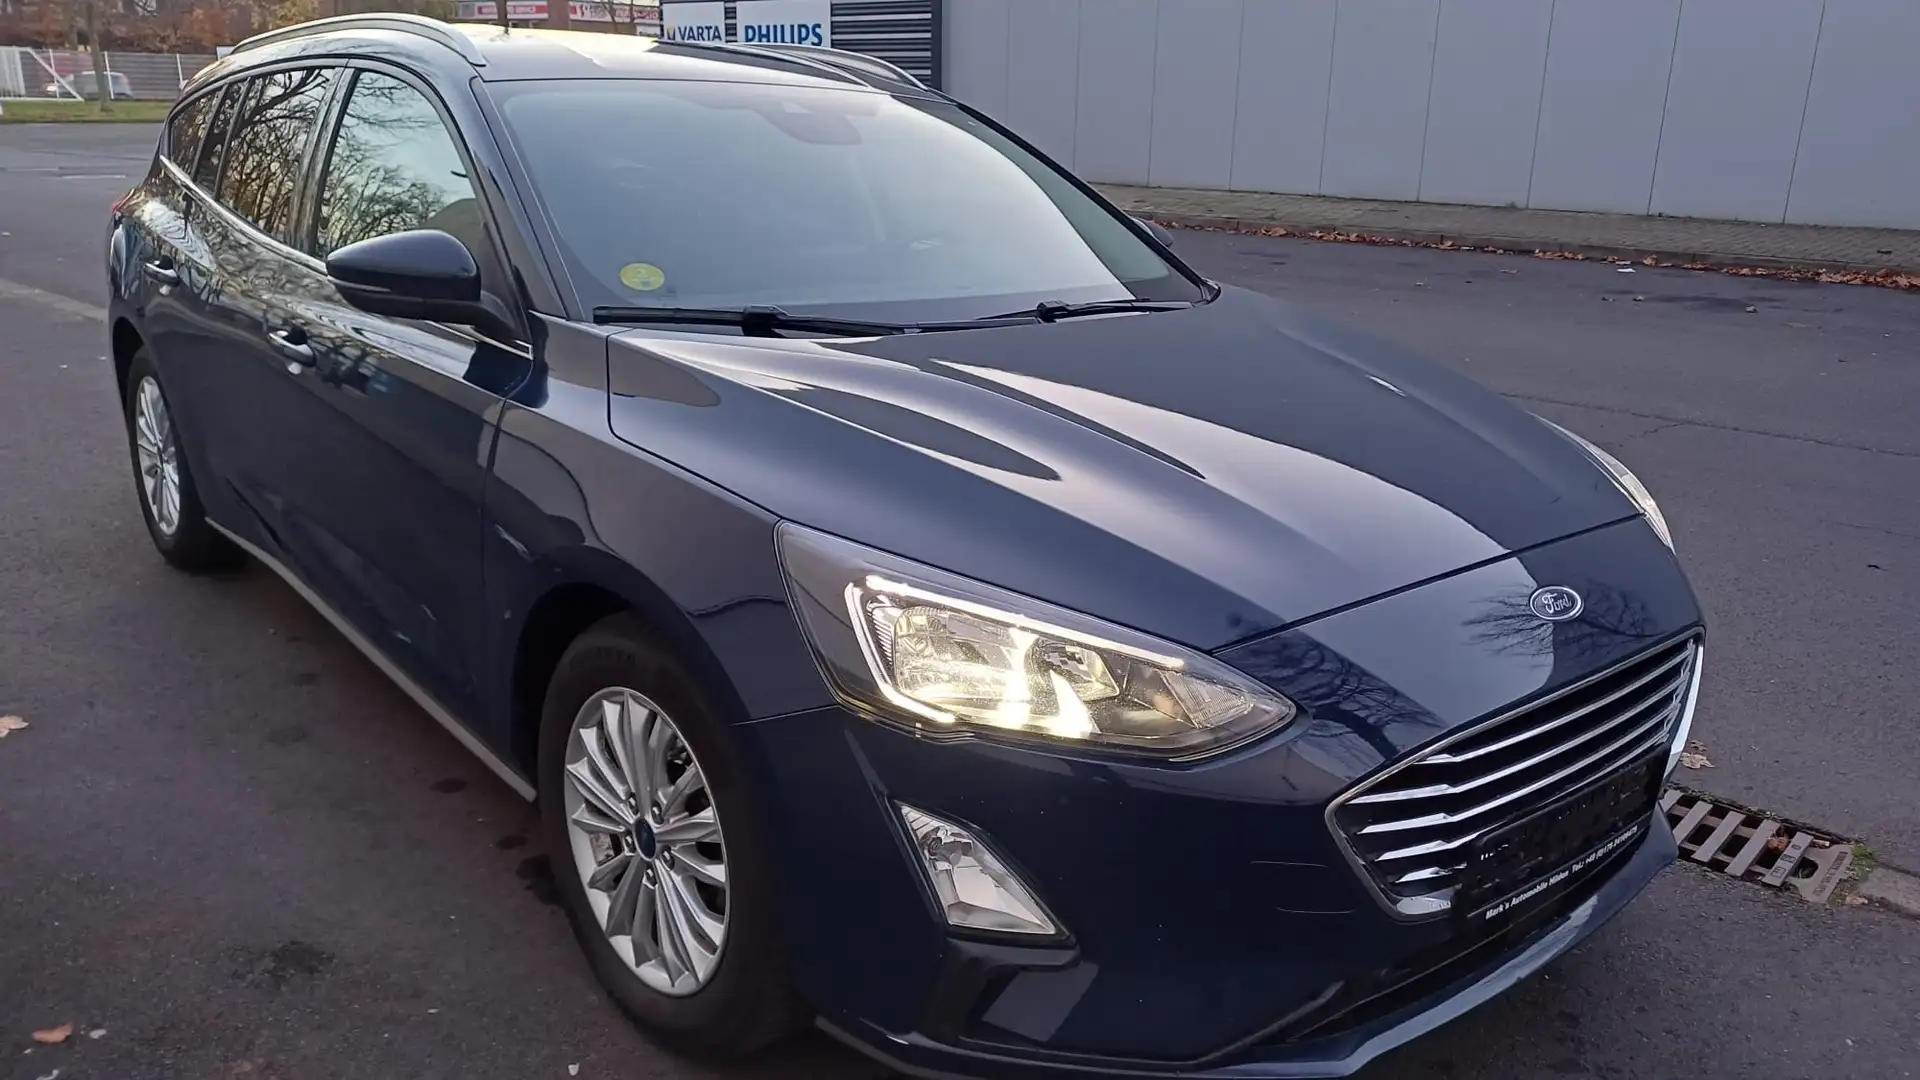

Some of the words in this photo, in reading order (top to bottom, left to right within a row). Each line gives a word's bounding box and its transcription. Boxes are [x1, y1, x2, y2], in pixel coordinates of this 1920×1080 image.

[678, 25, 722, 42] VARTA
[744, 23, 823, 47] PHILIPS
[1541, 592, 1572, 614] Ford
[1510, 881, 1549, 907] Automobile
